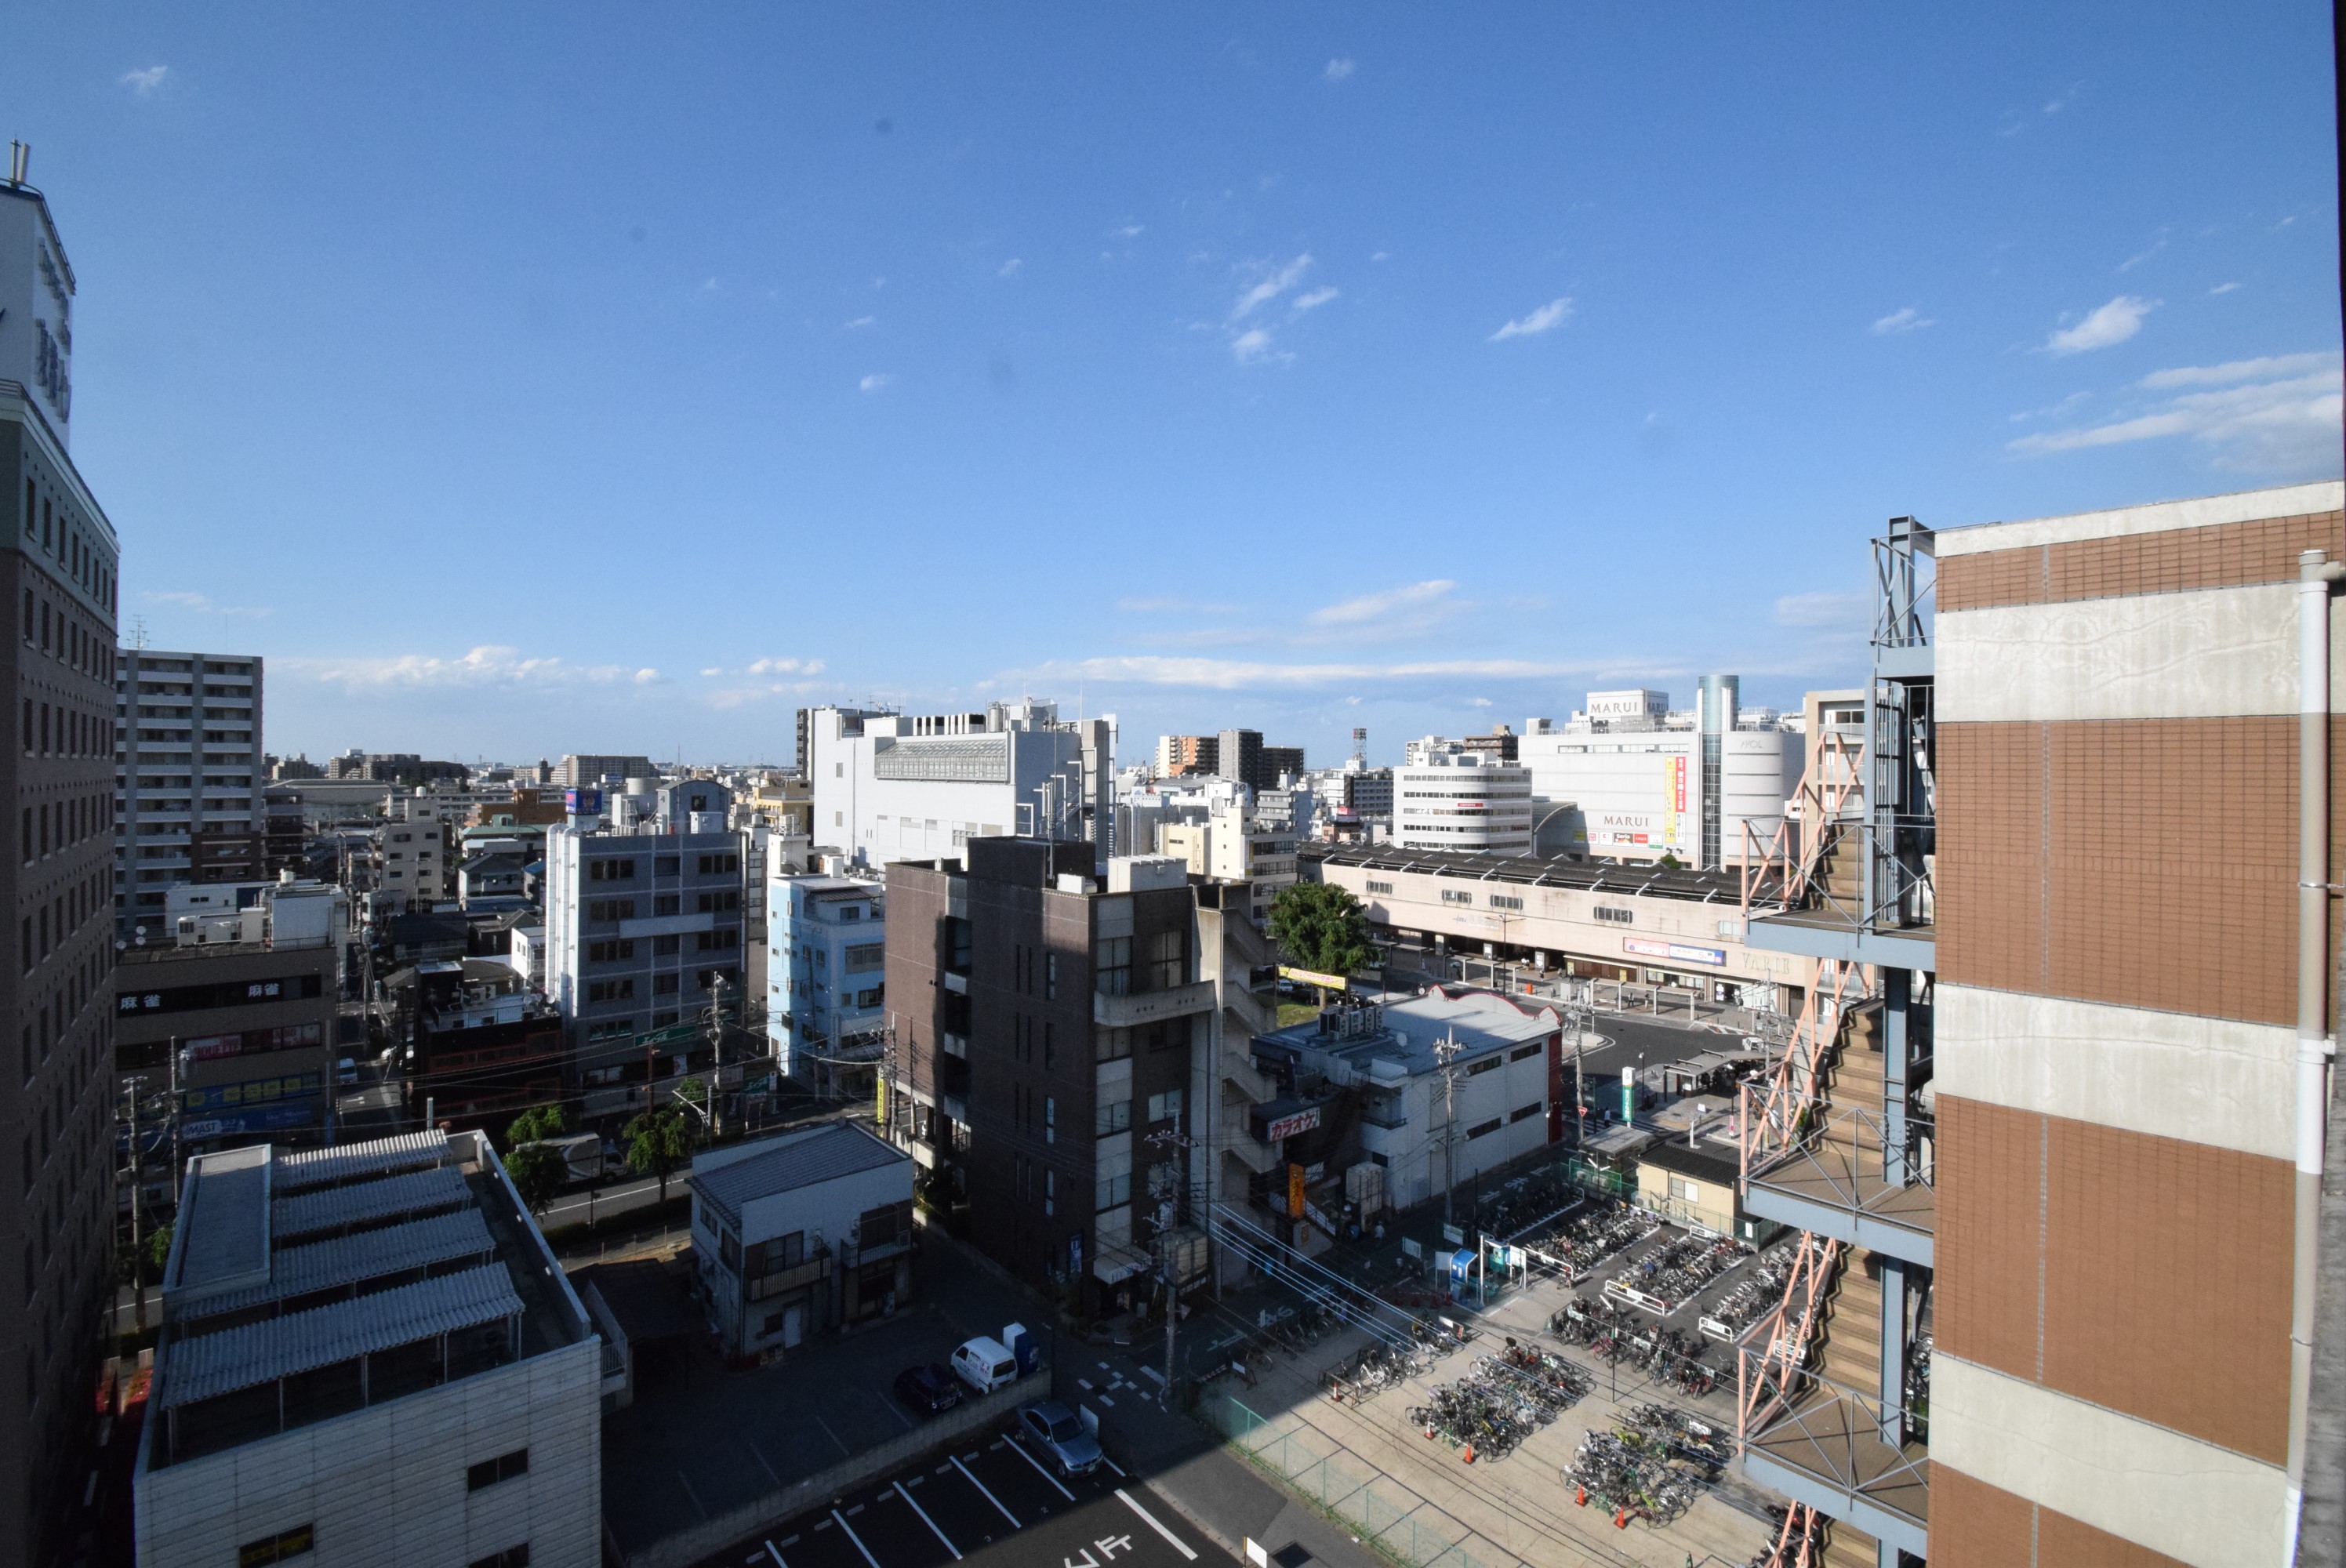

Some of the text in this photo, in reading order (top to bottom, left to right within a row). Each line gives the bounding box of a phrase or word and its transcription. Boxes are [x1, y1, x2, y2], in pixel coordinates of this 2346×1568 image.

[1590, 702, 1638, 713] MARUI
[1603, 815, 1649, 827] MARUI
[1741, 952, 1789, 975] VARIE
[248, 982, 281, 997] 麻雀
[120, 994, 162, 1011] 麻雀
[1271, 1112, 1316, 1140] カラオケ
